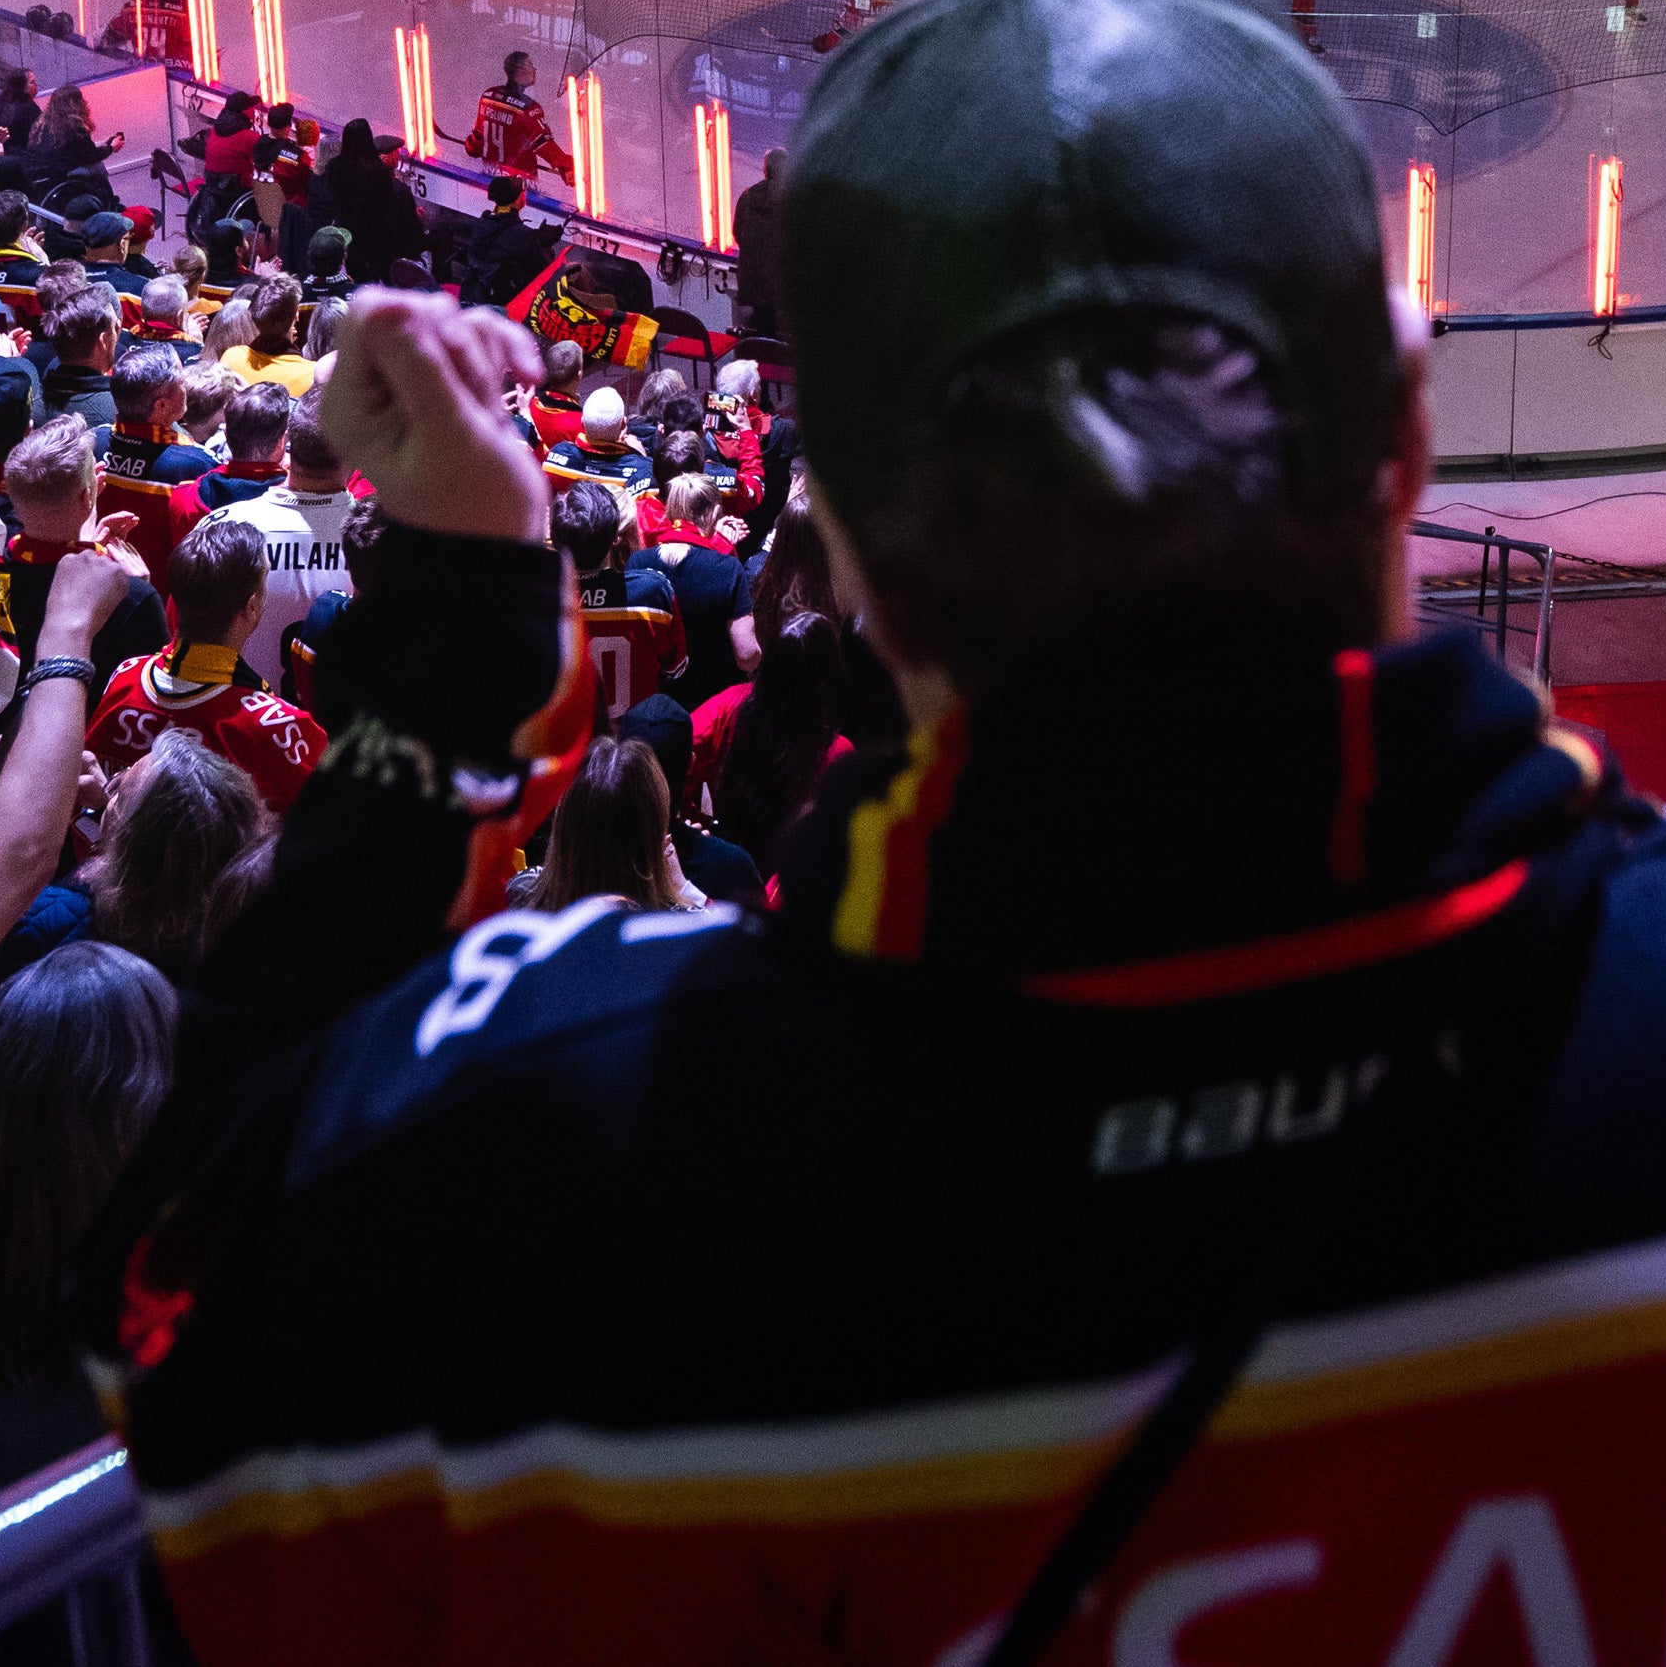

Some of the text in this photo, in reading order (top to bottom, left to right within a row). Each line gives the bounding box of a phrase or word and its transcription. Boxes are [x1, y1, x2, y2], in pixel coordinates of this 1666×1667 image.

[482, 120, 505, 163] 14
[605, 327, 618, 350] 1977
[102, 451, 147, 477] SSAB
[266, 542, 343, 572] VILAH
[242, 691, 312, 766] SSAB
